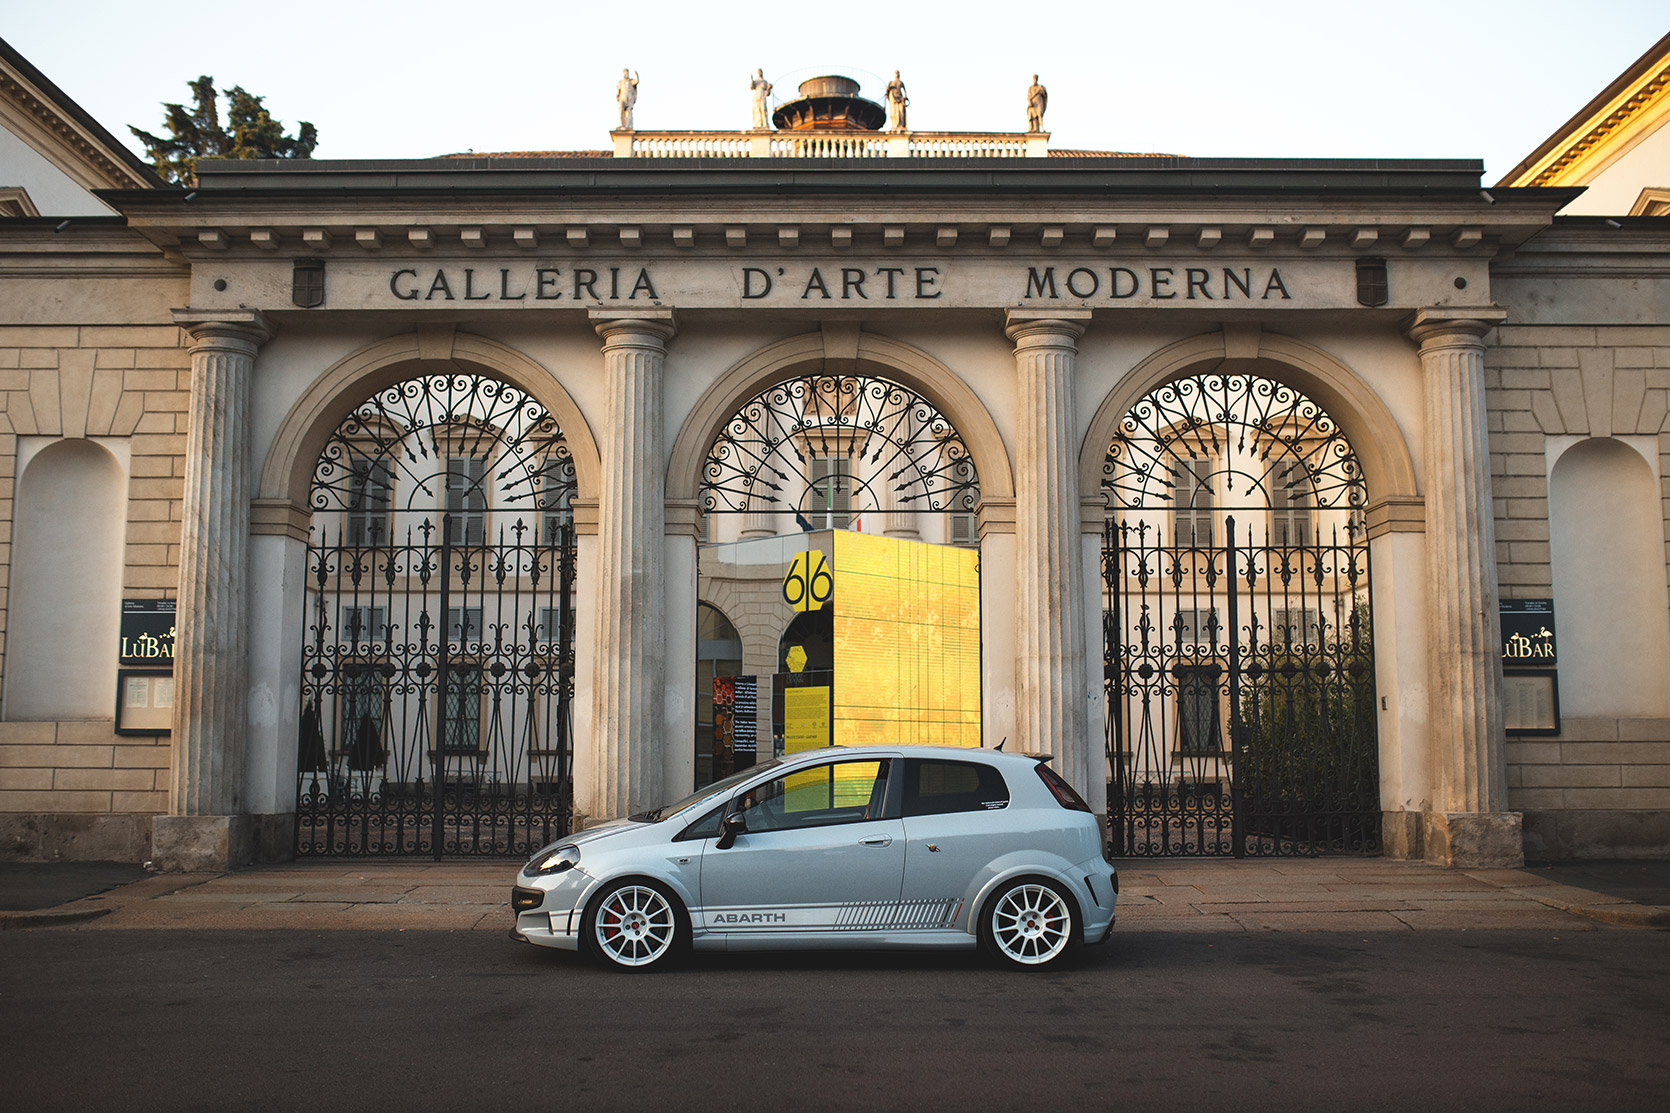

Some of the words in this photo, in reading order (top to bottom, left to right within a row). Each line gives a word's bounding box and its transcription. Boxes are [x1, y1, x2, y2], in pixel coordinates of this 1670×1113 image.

[389, 267, 660, 301] GALLERIA
[742, 267, 942, 300] D'ARTE
[1023, 266, 1292, 300] MODERNA
[713, 913, 786, 923] ABARTH
